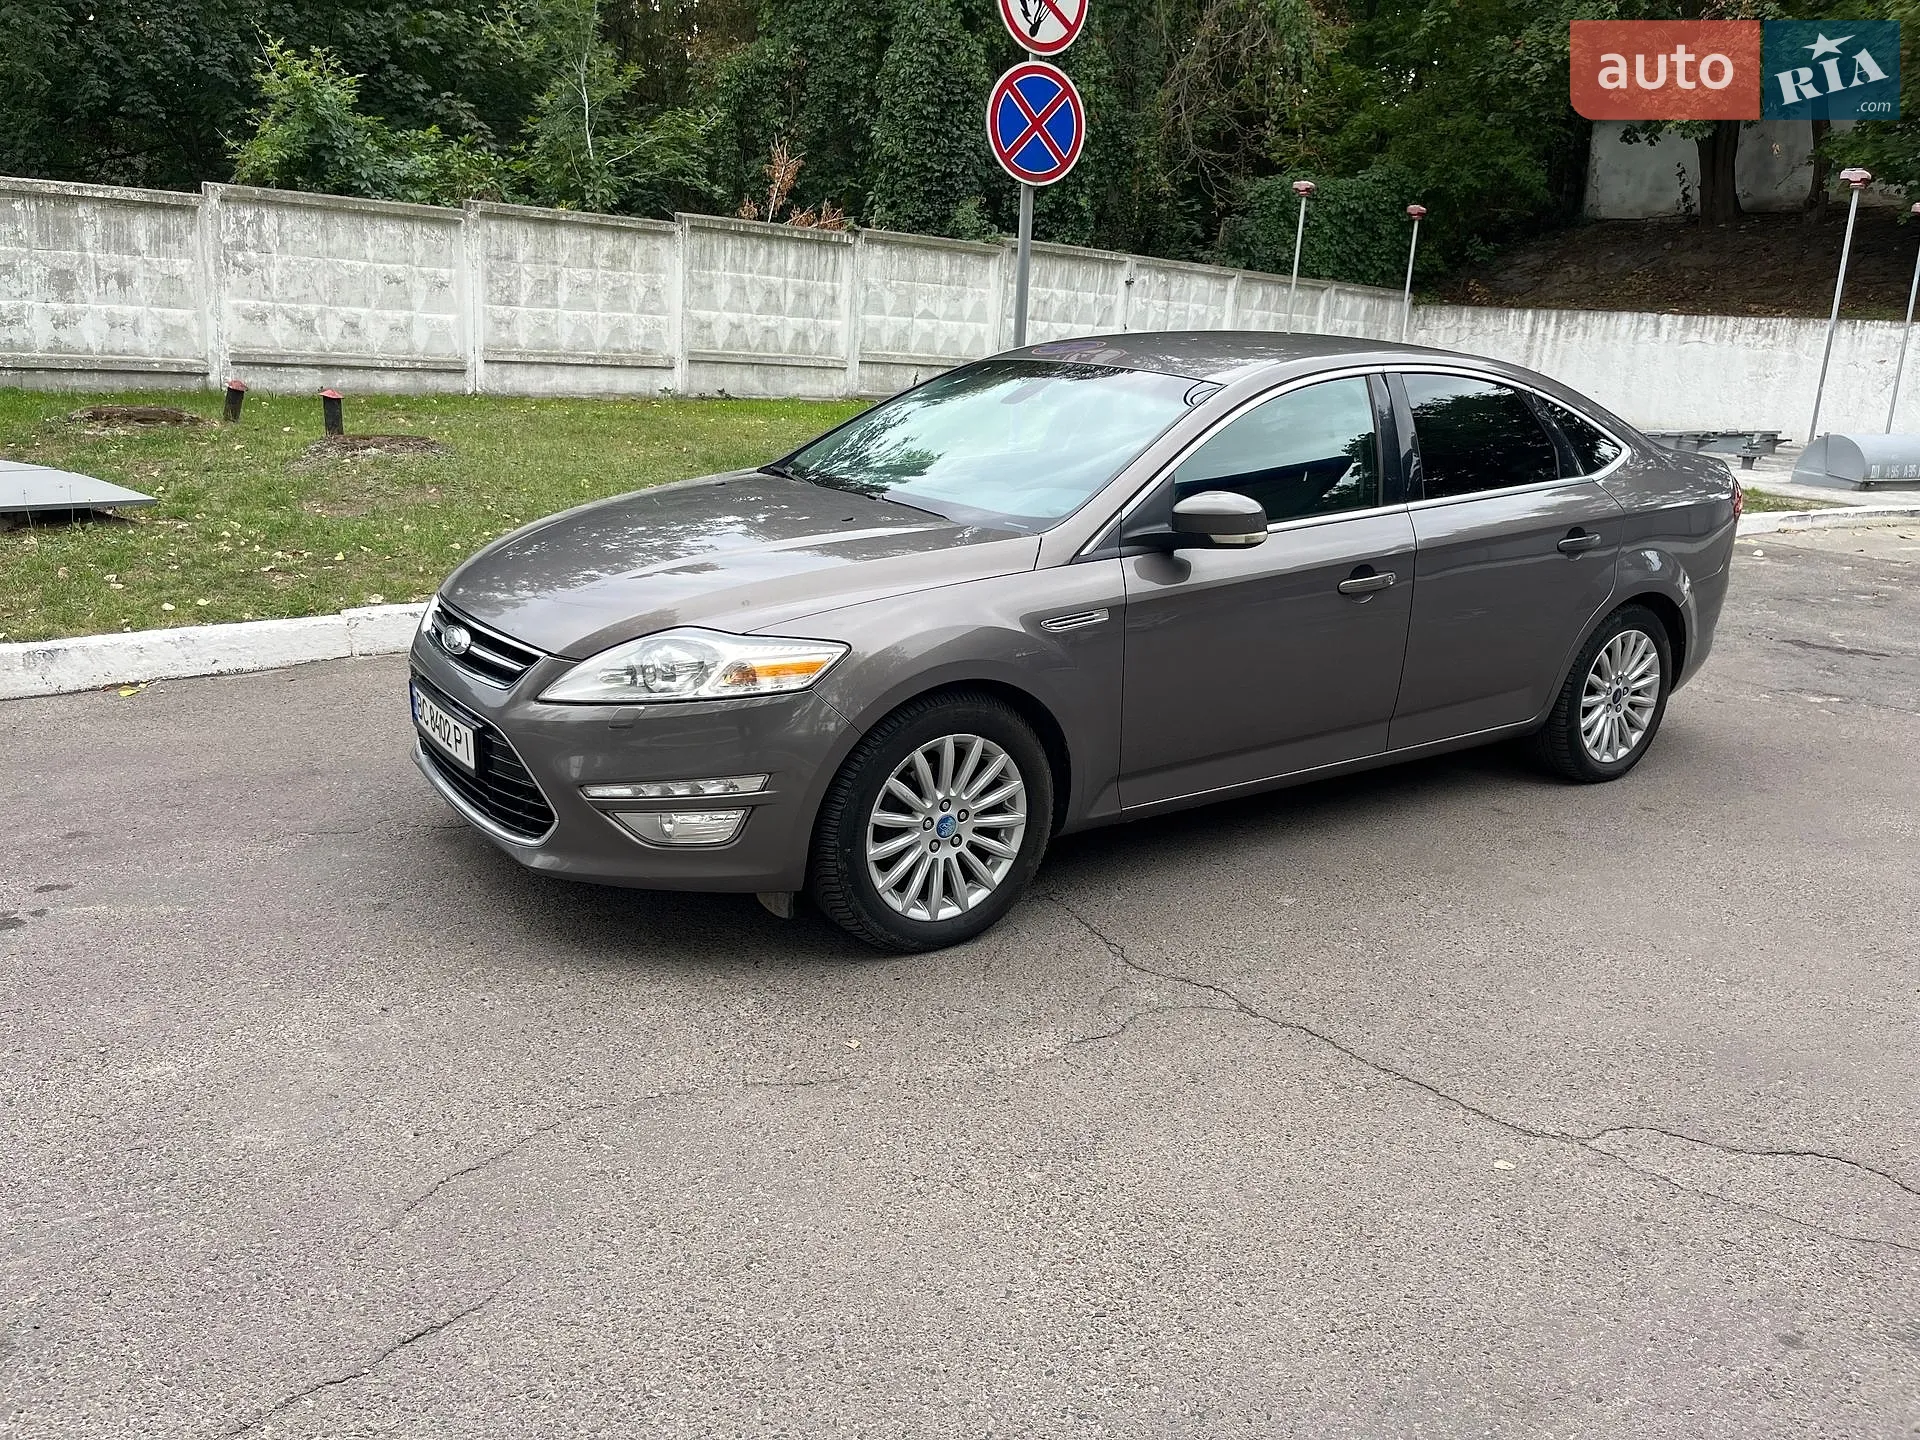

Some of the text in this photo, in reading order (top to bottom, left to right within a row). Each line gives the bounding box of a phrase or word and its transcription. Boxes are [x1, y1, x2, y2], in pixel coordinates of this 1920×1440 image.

[416, 692, 470, 762] BC 8402 PI
